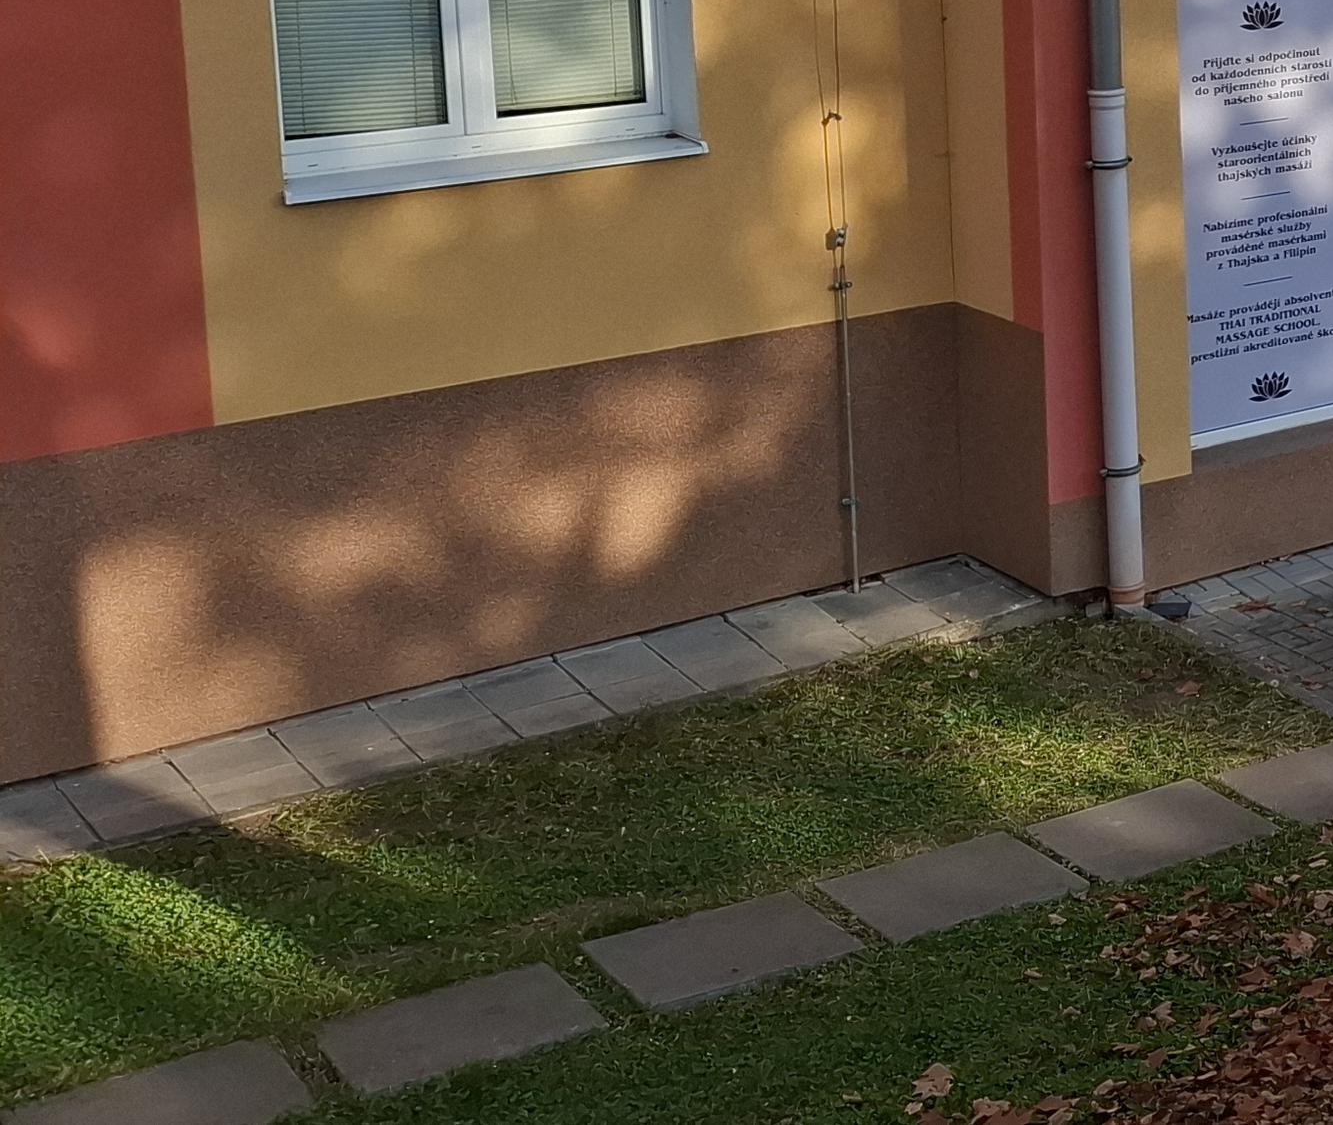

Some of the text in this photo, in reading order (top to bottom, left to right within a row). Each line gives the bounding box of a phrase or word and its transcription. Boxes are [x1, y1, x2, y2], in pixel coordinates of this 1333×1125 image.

[1204, 47, 1320, 69] Přijďte si odpočinout
[1192, 59, 1332, 83] od každodenních starostí
[1195, 73, 1330, 96] do příjemného prostředí
[1224, 89, 1303, 106] našeho salonu
[1211, 134, 1317, 157] Vyzkoušejte účinky
[1218, 148, 1311, 169] staroorientálních
[1218, 160, 1312, 182] thajských masáží
[1203, 205, 1328, 232] Nabízíme profesionální
[1221, 221, 1312, 243] masérské služby
[1206, 231, 1327, 261] prováděné masérkami
[1217, 245, 1317, 270] z Thajska a Filipín
[1219, 304, 1321, 332] THAI TRADITIONAL
[1229, 297, 1281, 319] provádějí
[1215, 327, 1270, 345] MASSAGE
[1190, 345, 1240, 365] prestižní
[1243, 331, 1314, 353] akreditované
